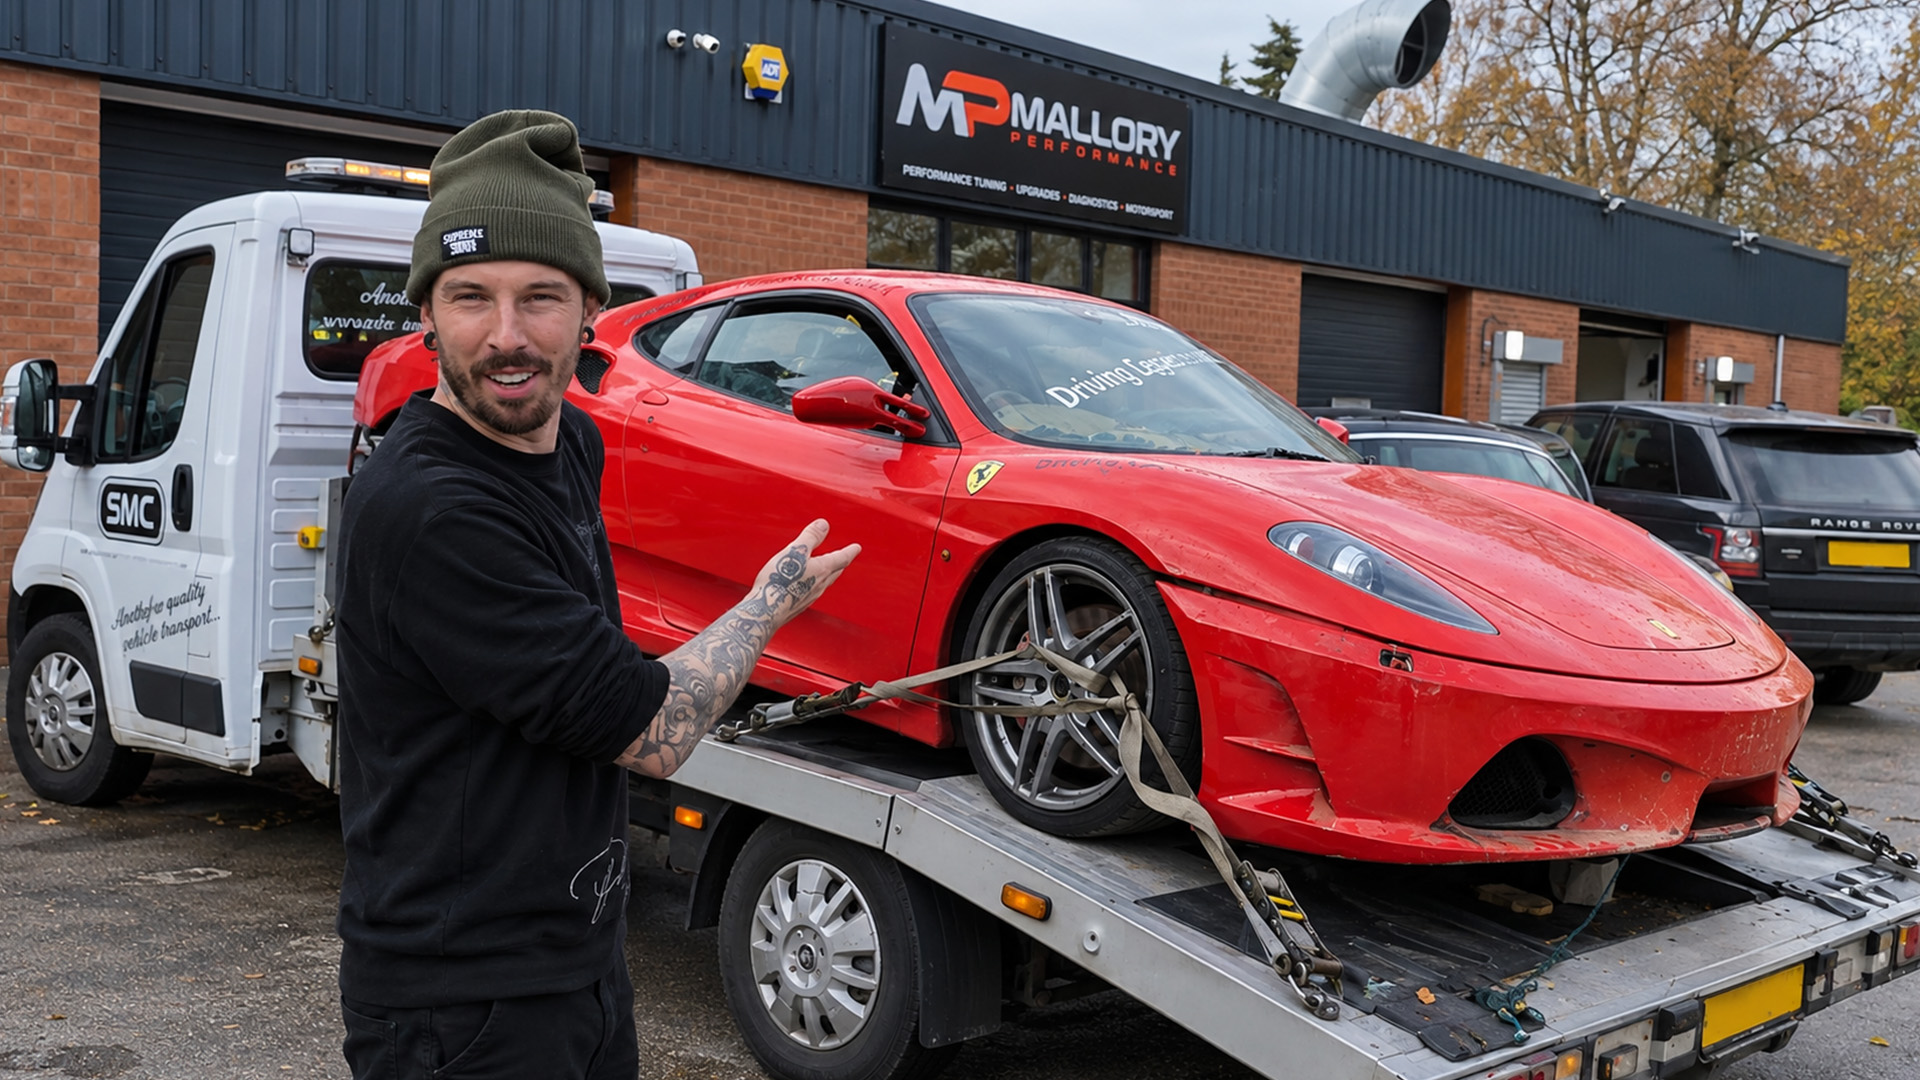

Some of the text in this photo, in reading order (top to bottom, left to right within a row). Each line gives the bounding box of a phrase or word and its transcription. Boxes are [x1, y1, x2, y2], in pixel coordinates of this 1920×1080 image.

[761, 62, 780, 78] ADT
[1010, 91, 1181, 161] MALLORY
[1010, 131, 1177, 176] PERFORMANCE
[902, 164, 1174, 221] PERFORMANCE TUNING UPGRADES DIAGNOSTICS MOTORSPORT
[1045, 366, 1144, 409] Driving
[106, 491, 155, 530] SMC
[1810, 518, 1871, 529] RANGE
[166, 581, 205, 617] quality
